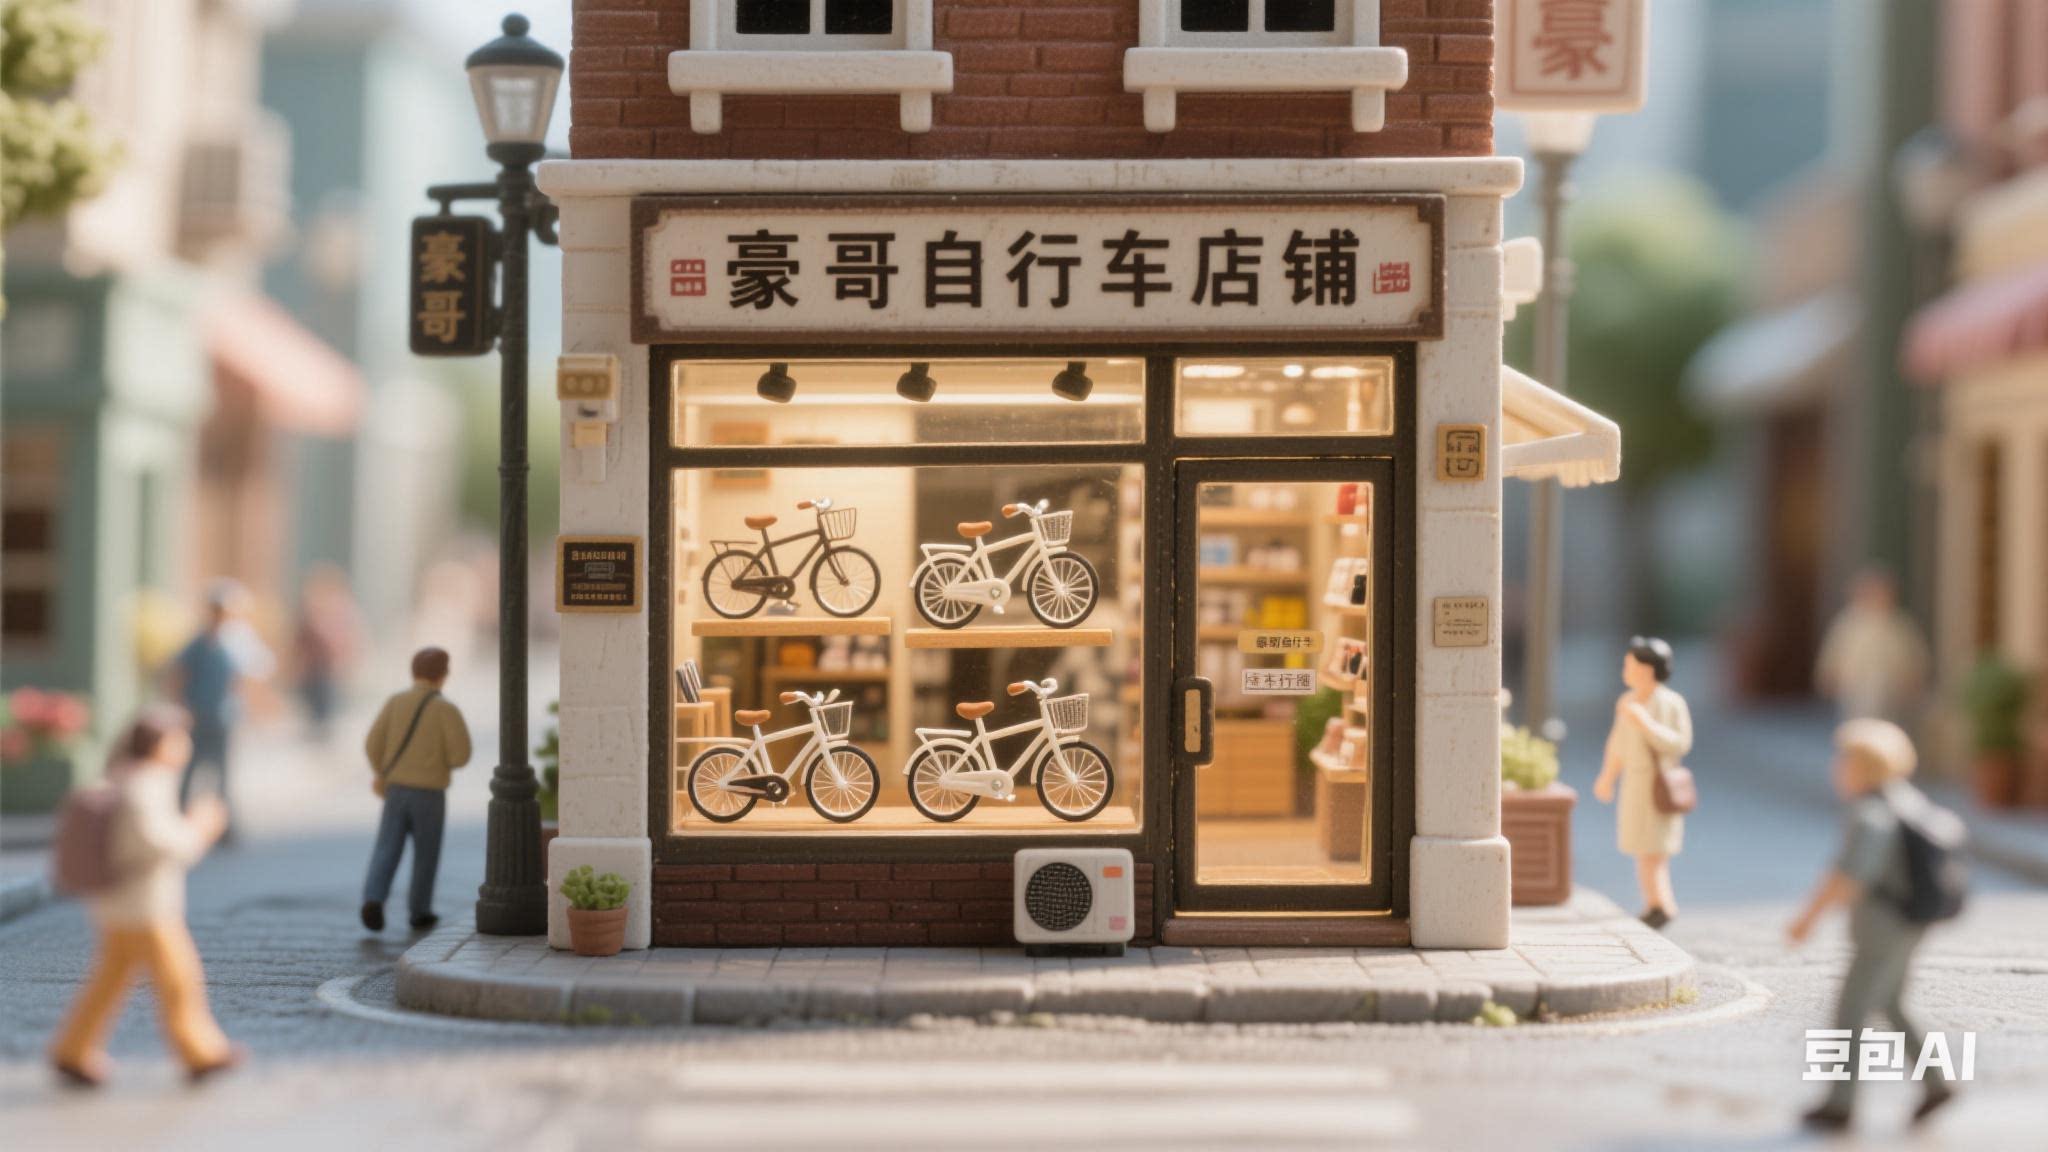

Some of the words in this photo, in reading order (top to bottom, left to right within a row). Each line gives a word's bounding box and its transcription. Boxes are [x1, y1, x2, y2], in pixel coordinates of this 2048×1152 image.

[1531, 0, 1613, 79] 豪
[417, 230, 467, 344] 豪哥
[726, 228, 1360, 310] 豪哥自行车店铺
